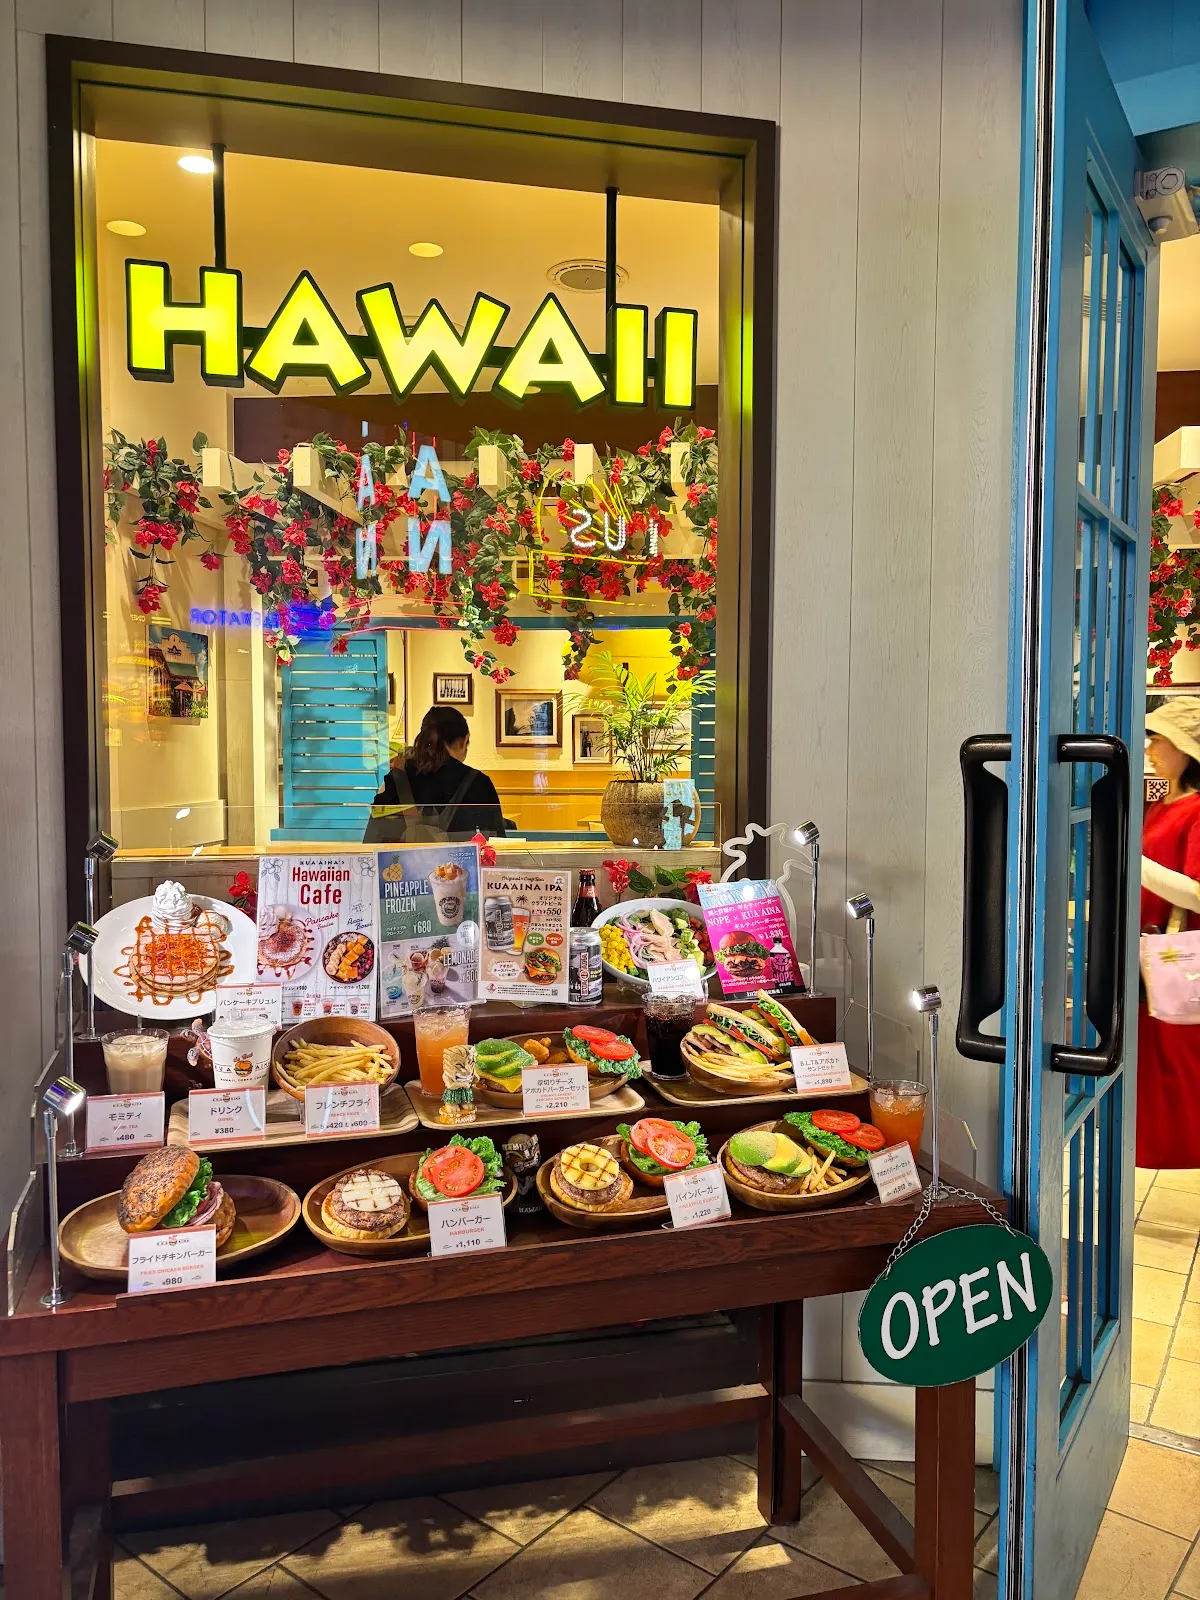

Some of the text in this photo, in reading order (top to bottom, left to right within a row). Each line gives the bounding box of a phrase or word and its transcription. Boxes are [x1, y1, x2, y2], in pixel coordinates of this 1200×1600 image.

[126, 259, 698, 409] HAWAII
[292, 866, 350, 882] Hawaiian
[300, 883, 342, 905] Cafe
[384, 879, 429, 898] PINEAPPLE
[545, 883, 563, 892] IPA
[385, 897, 417, 915] FROZEN
[413, 920, 432, 934] ¥680
[707, 915, 731, 927] NOPE
[443, 948, 479, 967] LEMONADE
[219, 998, 277, 1006] パンケーキブリュレ
[537, 1077, 574, 1086] 厚切りチーズ
[524, 1085, 587, 1094] アボカドバーガーセット
[210, 1105, 243, 1116] ドリンク
[315, 1098, 371, 1110] フレンチフライ
[546, 1101, 568, 1109] ¥2,210
[108, 1112, 142, 1121] モミティ
[675, 1185, 720, 1203] パインバーガー
[441, 1214, 491, 1229] ハンバーガー
[449, 1227, 485, 1236] HAMBURGER
[455, 1238, 481, 1249] ¥1,110
[132, 1249, 213, 1265] フライドチキンバーガー
[880, 1252, 1037, 1360] OPEN
